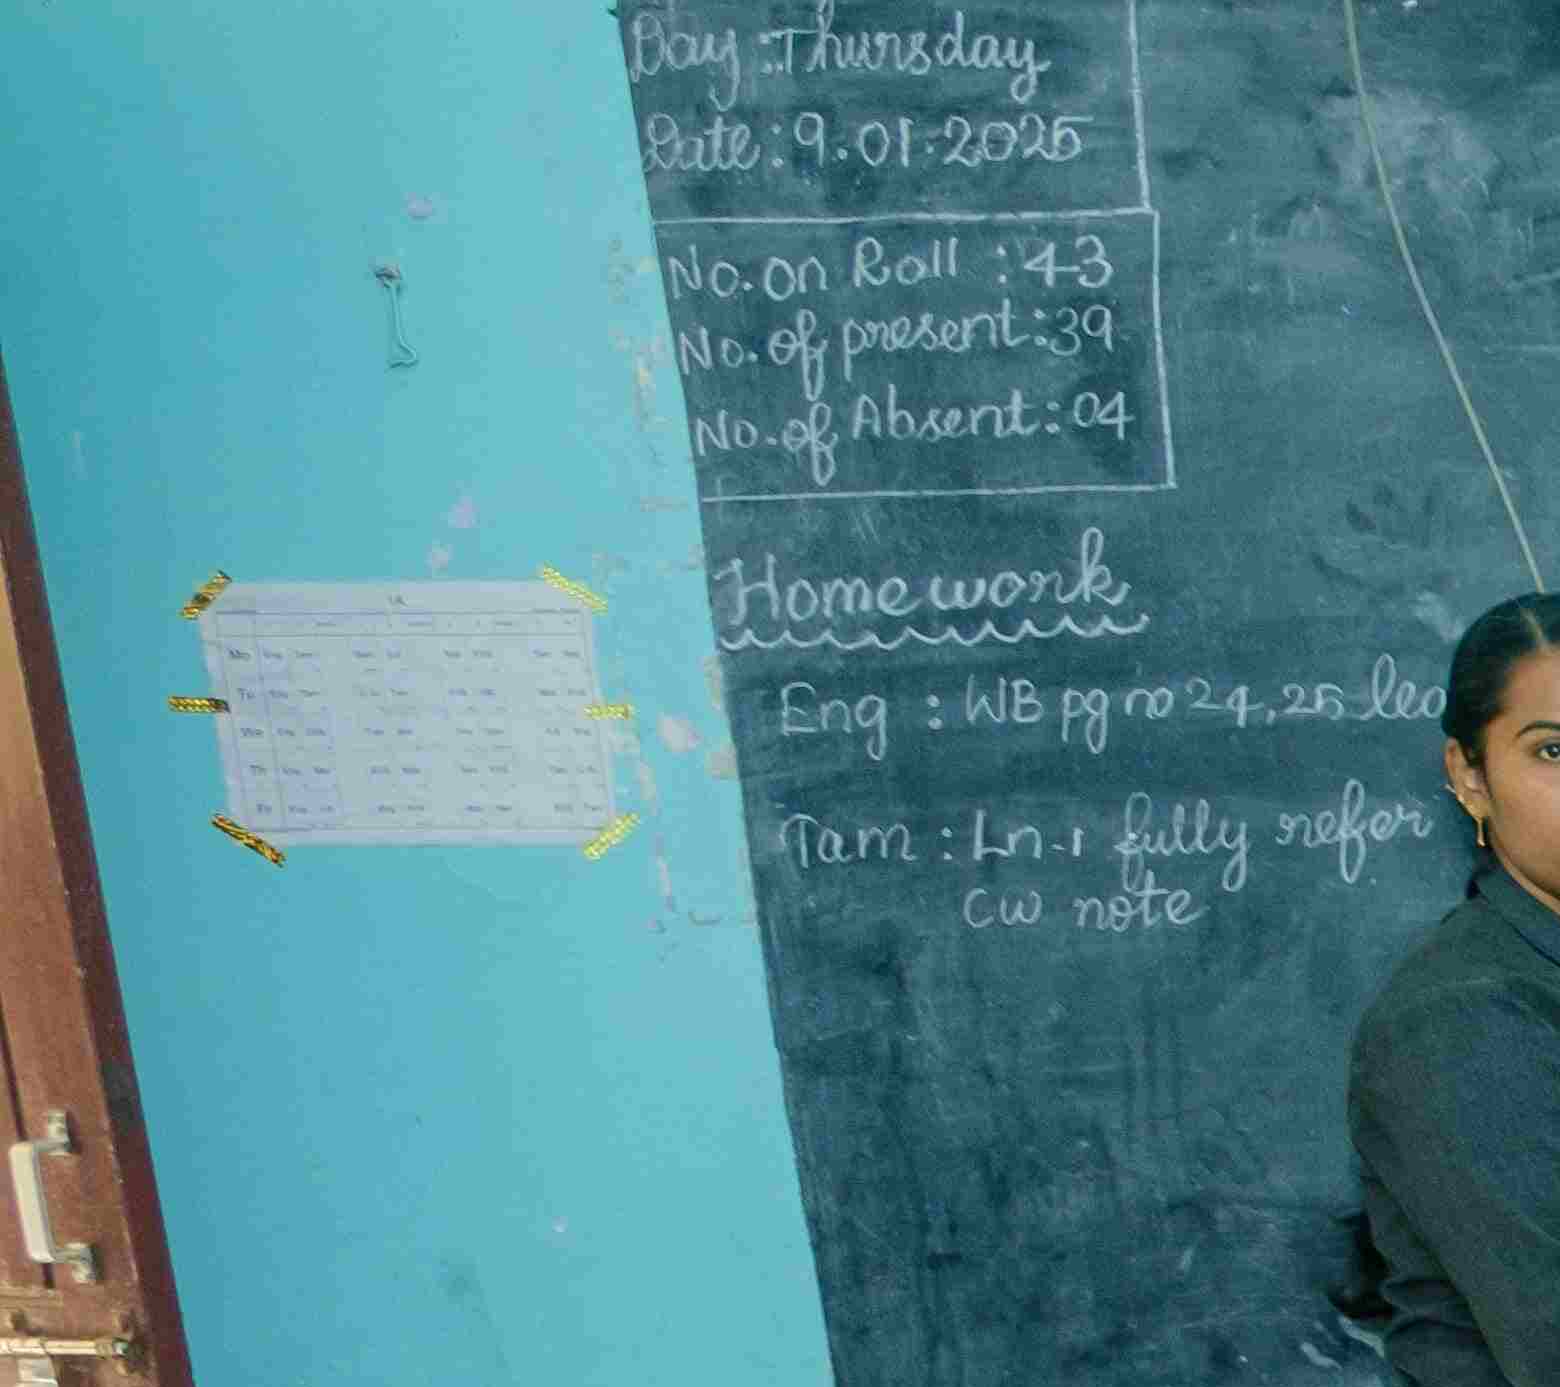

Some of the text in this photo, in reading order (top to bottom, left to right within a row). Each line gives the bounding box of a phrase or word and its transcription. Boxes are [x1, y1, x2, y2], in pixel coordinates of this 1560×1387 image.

[631, 11, 741, 111] Day
[854, 236, 958, 288] Roll
[780, 682, 886, 760] Eng
[964, 674, 1044, 726] WB
[1061, 682, 1111, 755] pg
[777, 812, 916, 870] Tam
[1114, 791, 1250, 893] fully
[1275, 778, 1433, 884] refer
[1074, 872, 1201, 932] note
